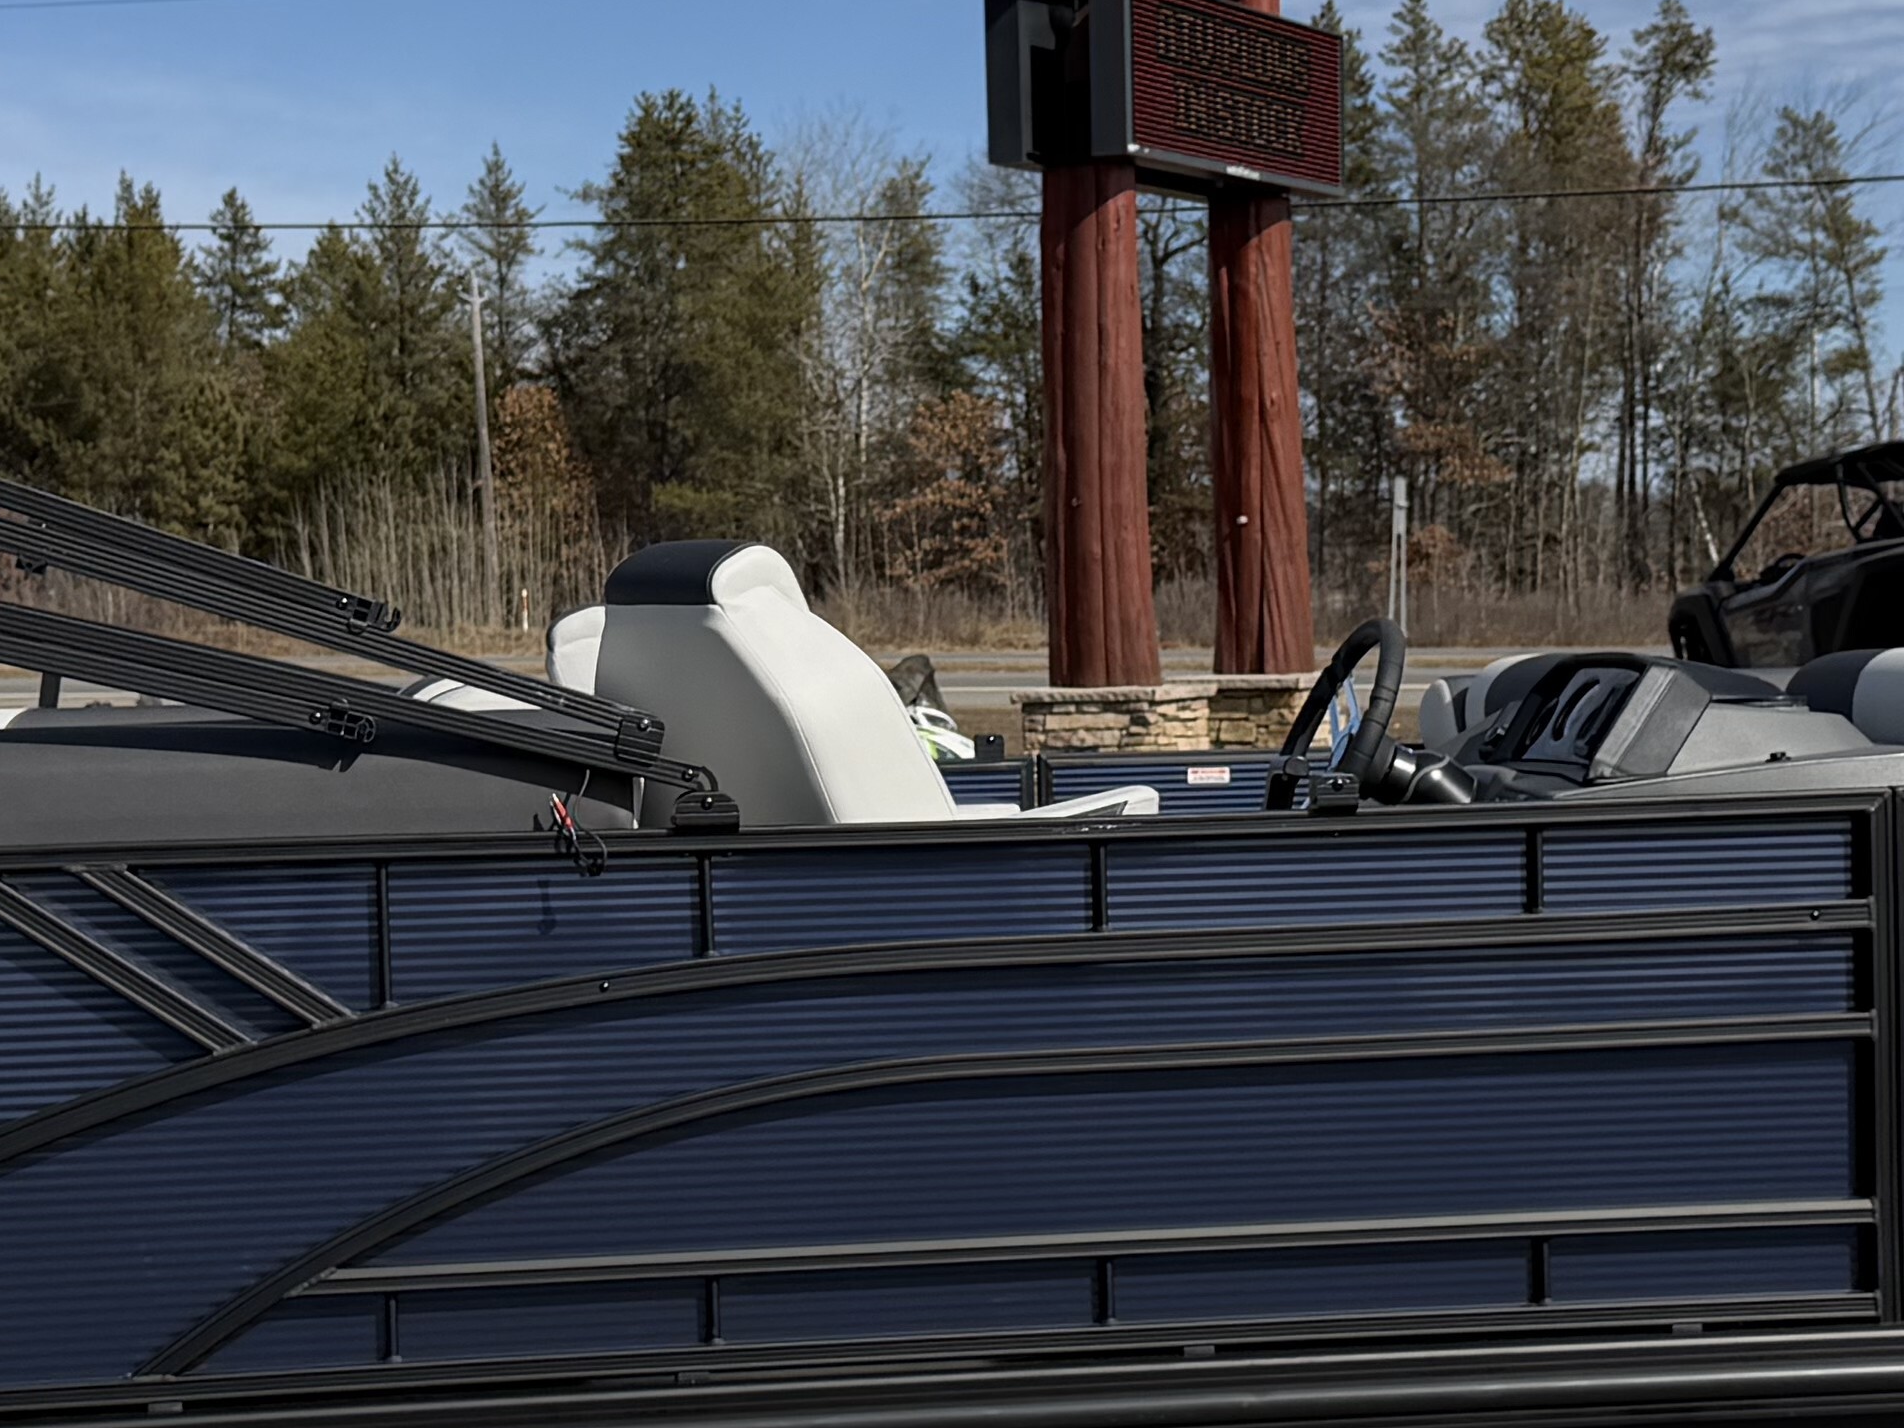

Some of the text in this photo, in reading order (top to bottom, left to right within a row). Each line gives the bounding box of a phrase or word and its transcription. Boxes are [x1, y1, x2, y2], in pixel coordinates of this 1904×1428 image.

[1157, 6, 1308, 93] ATV PLOWS
[1175, 78, 1304, 154] IN STOCK
